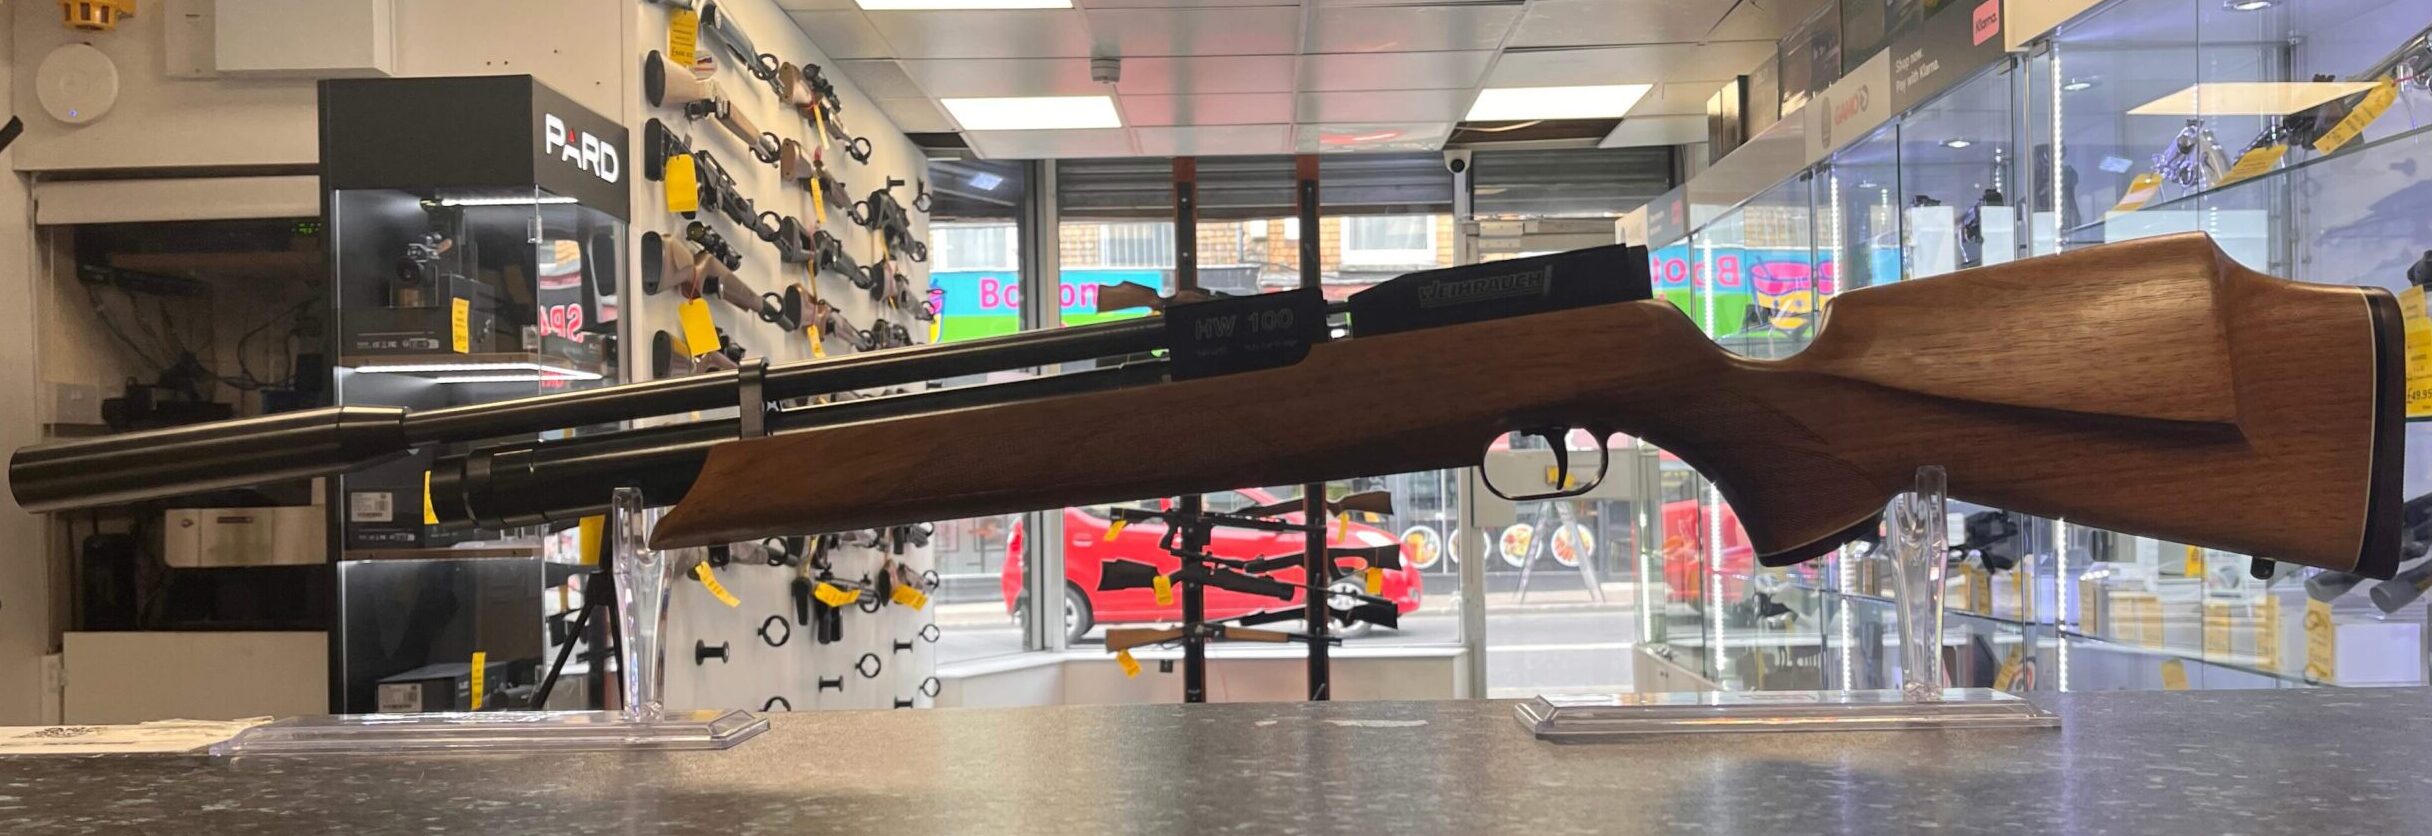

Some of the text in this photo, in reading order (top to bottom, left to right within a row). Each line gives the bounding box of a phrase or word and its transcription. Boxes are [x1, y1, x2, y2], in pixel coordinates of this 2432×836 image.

[545, 112, 620, 184] PARD
[1419, 269, 1545, 302] WEIHRAUCH
[1194, 307, 1295, 340] HW 100
